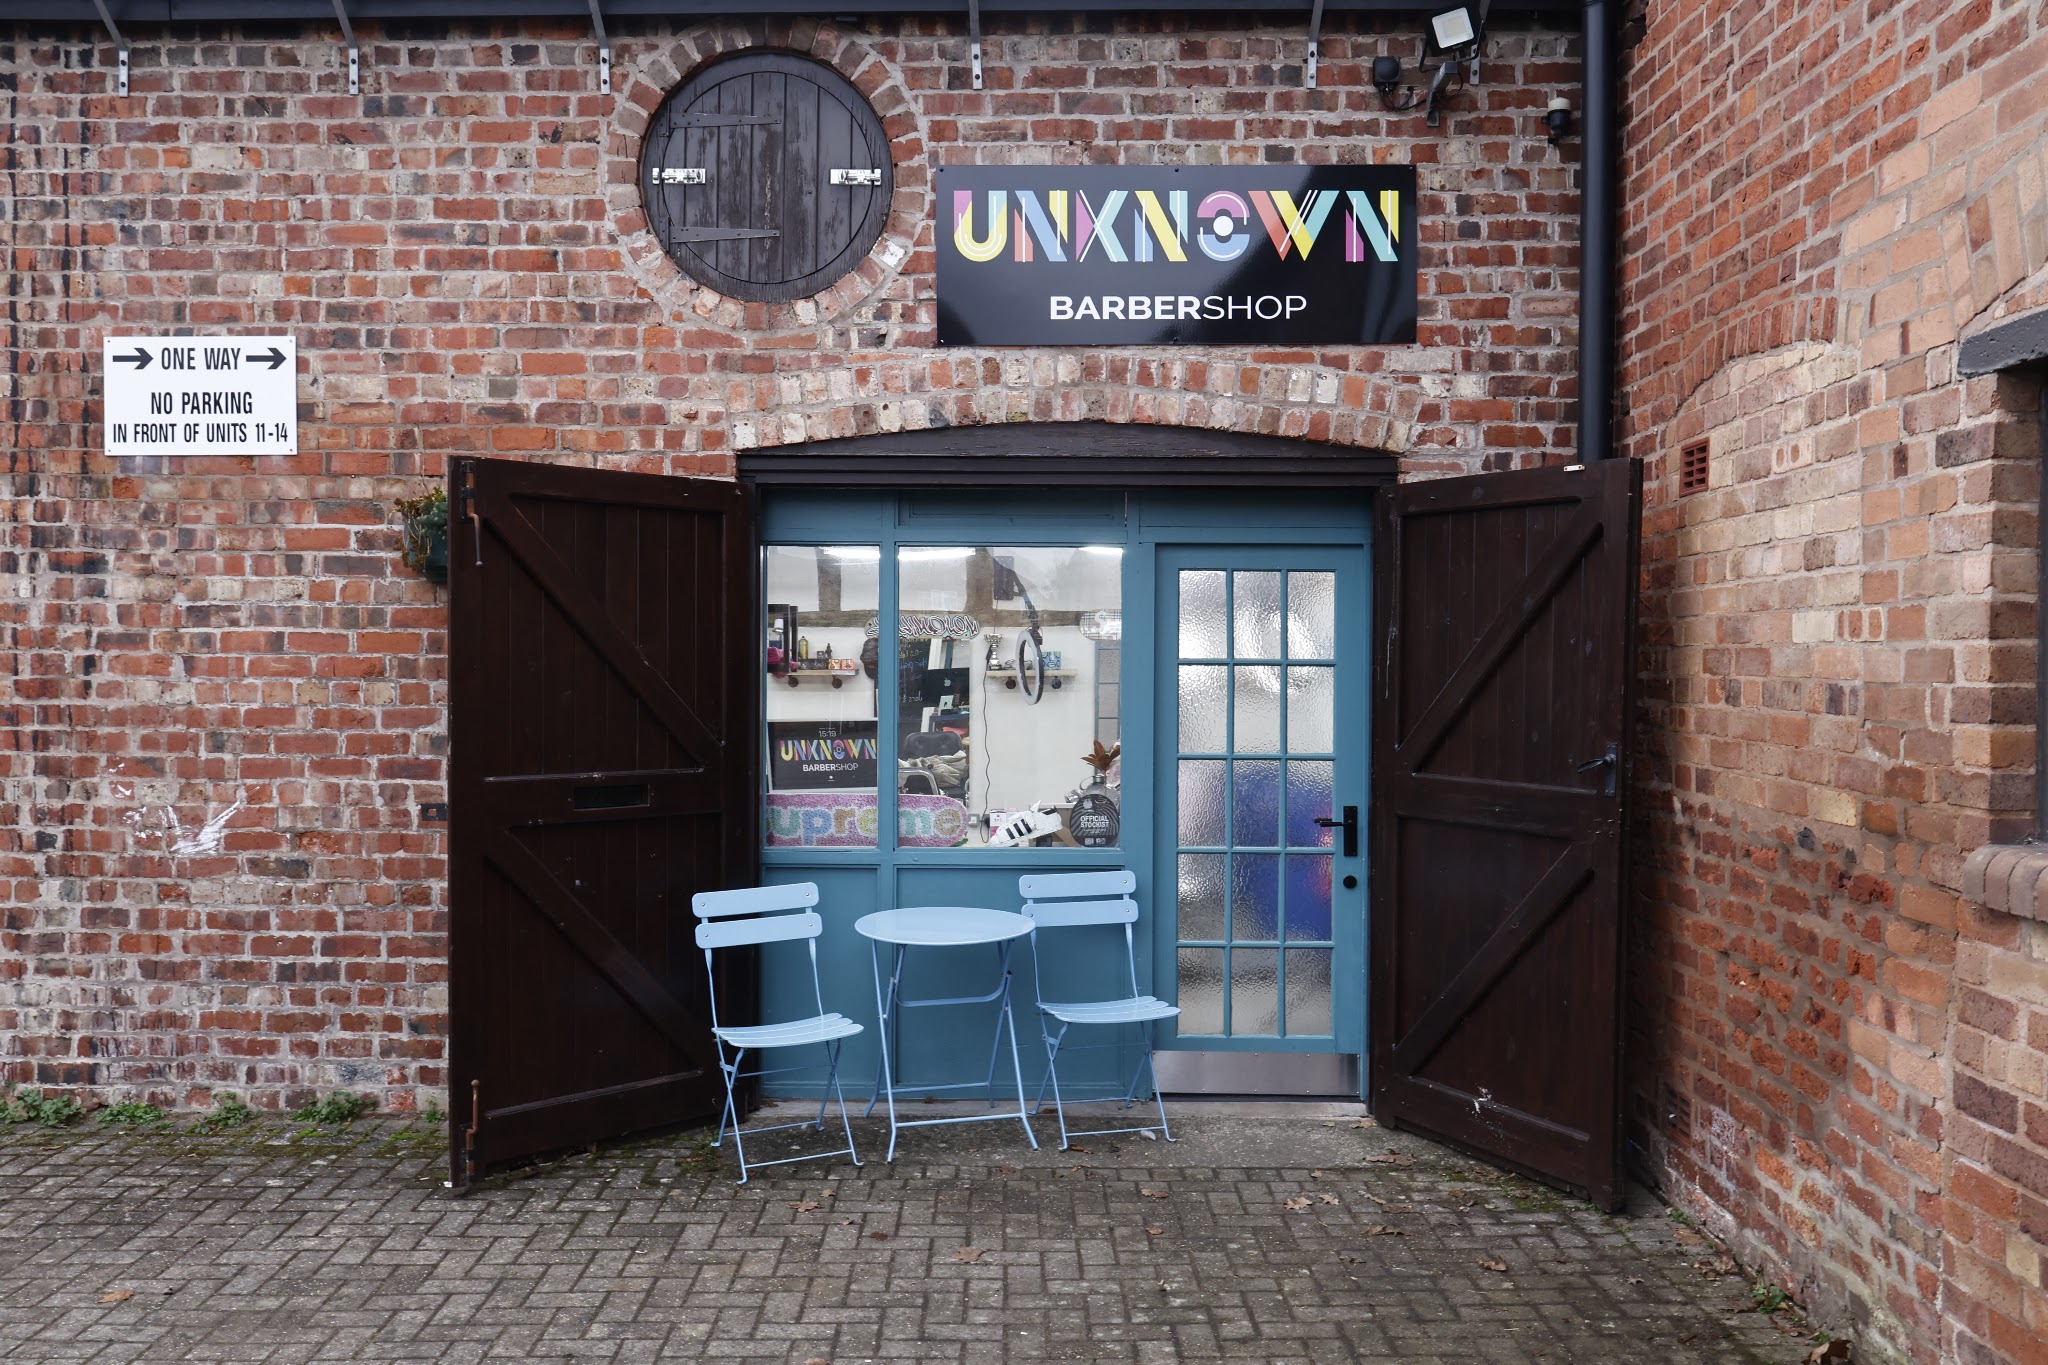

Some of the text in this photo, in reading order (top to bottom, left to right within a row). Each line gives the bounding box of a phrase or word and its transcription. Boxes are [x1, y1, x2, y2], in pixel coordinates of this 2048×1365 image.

[1050, 295, 1307, 320] BARBERSHOP
[161, 347, 241, 370] ONE WAY
[151, 391, 253, 415] NO PARKING
[113, 422, 288, 443] IN FRONT OF UNITS 11-14
[818, 730, 837, 738] 15:19
[780, 738, 877, 761] UNKNOWN
[803, 762, 859, 772] BARBERSHOP
[766, 807, 963, 846] upreme
